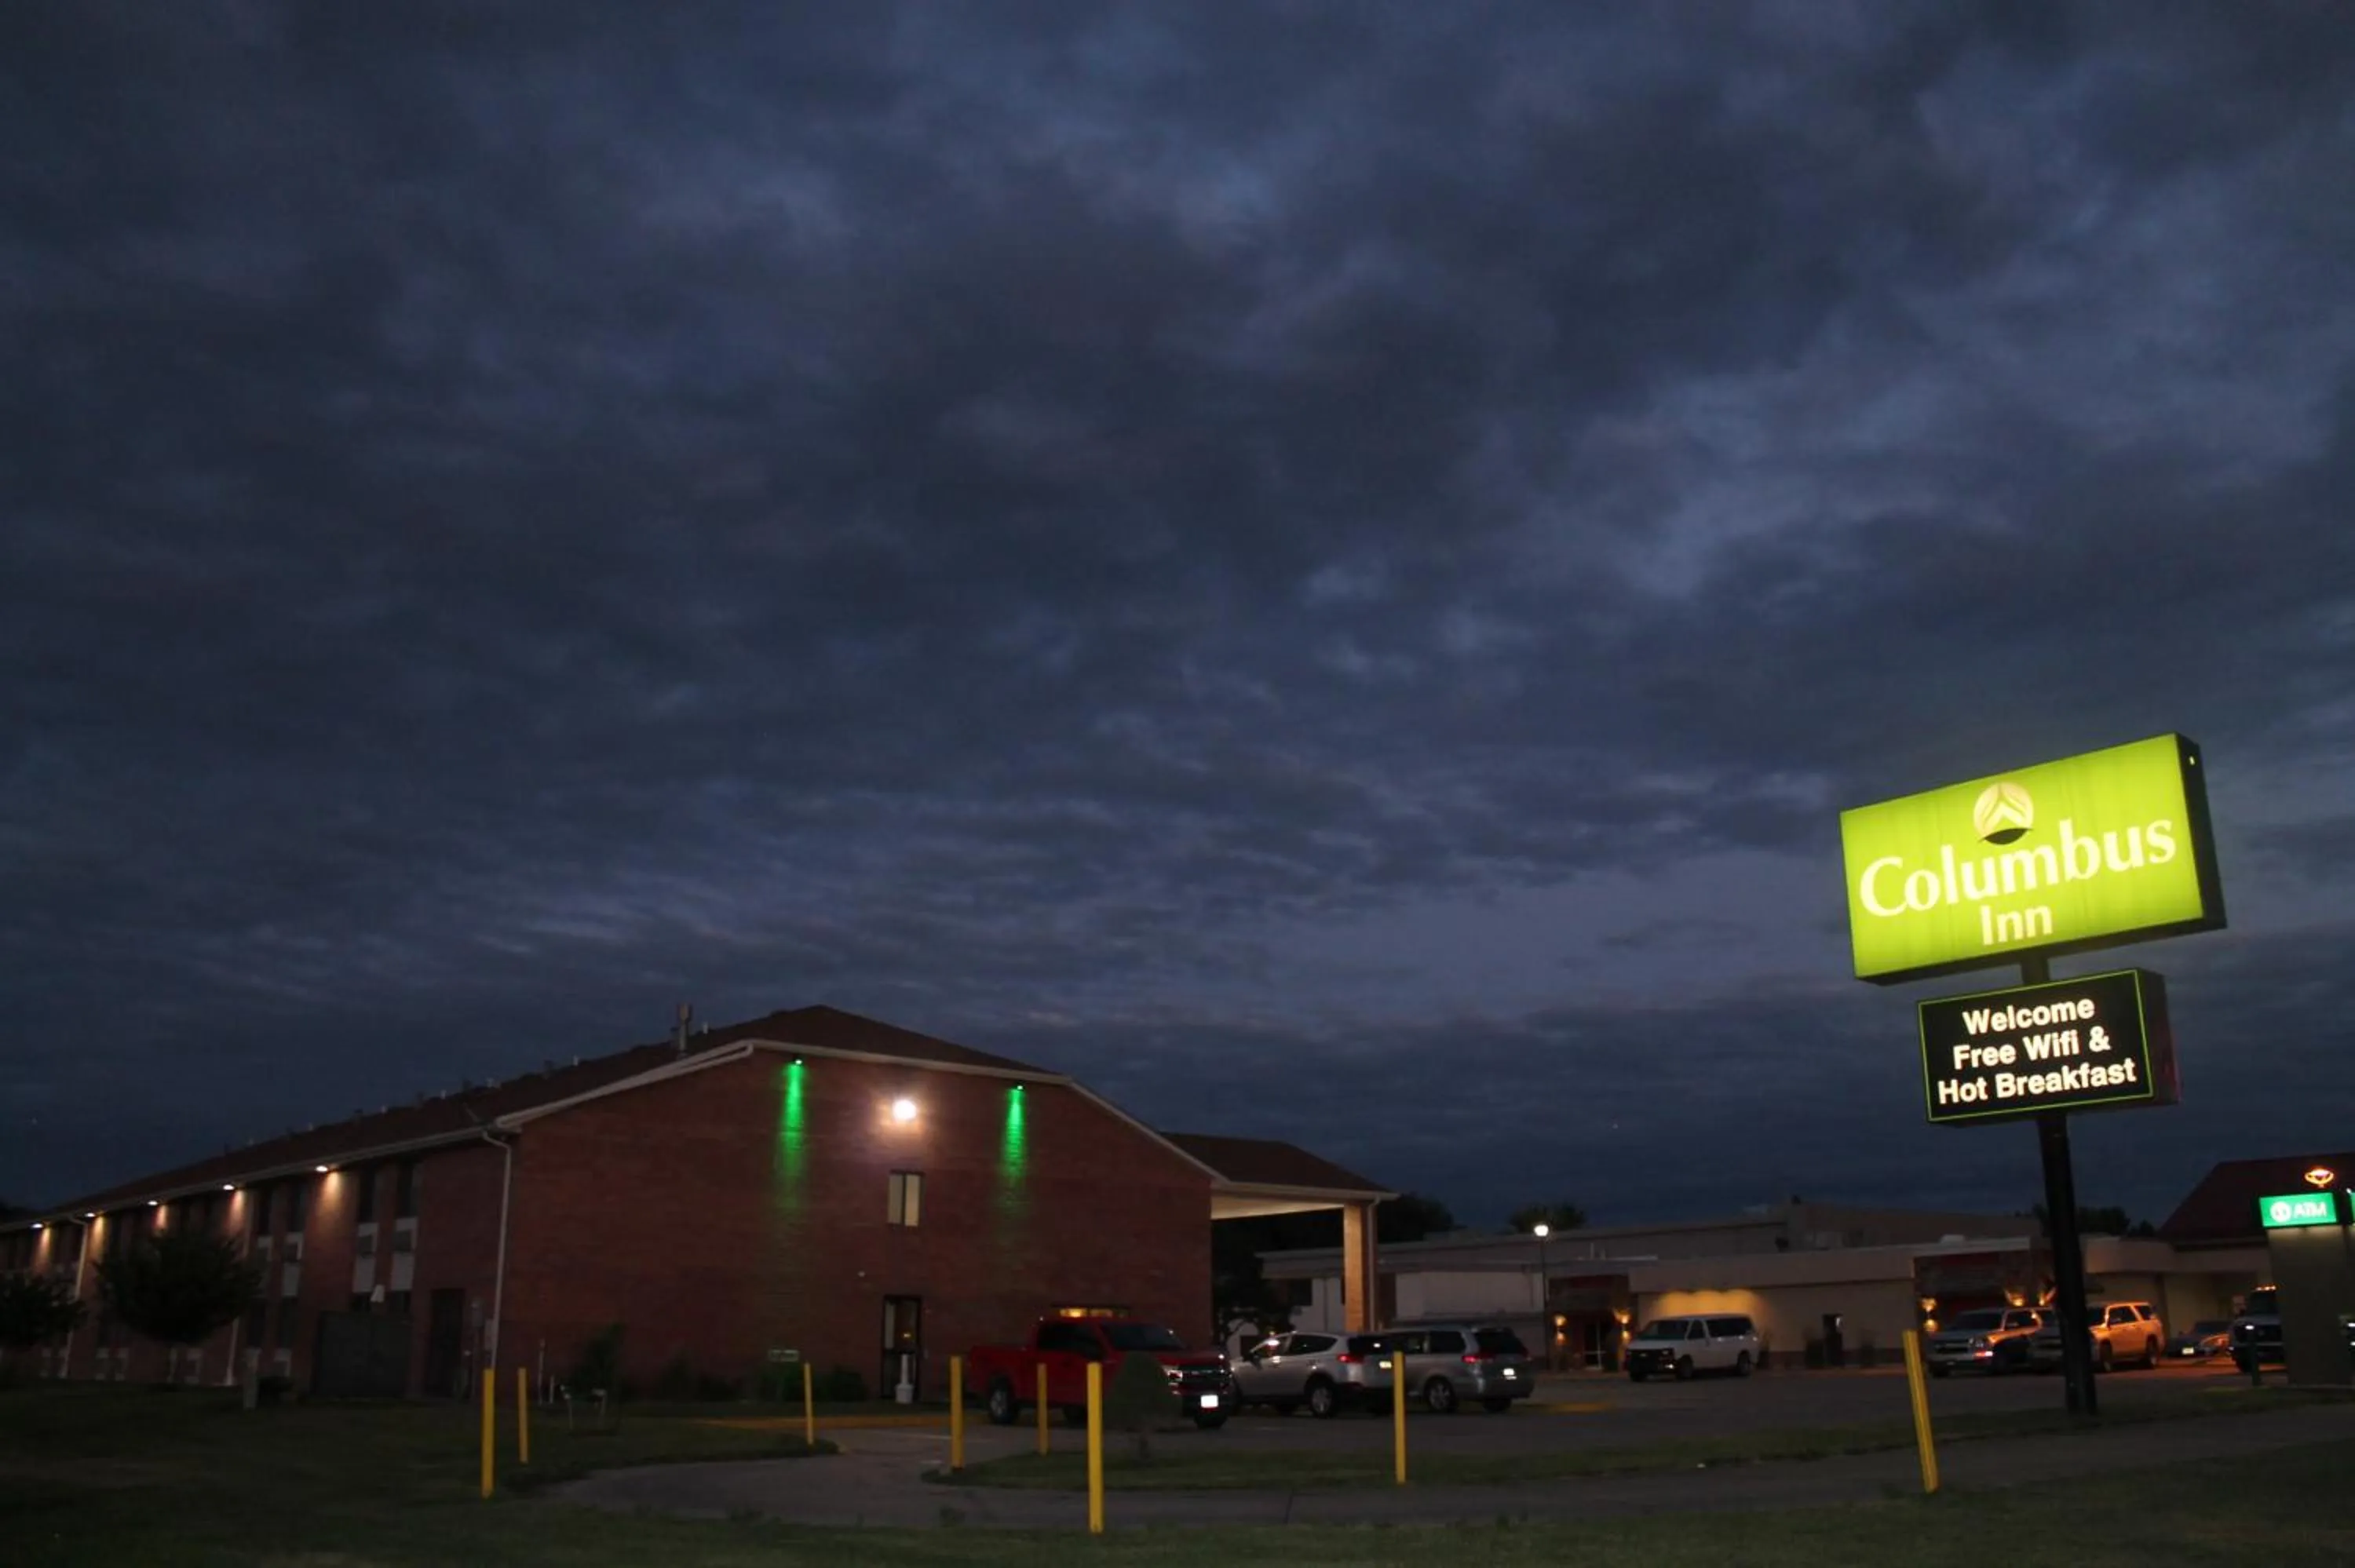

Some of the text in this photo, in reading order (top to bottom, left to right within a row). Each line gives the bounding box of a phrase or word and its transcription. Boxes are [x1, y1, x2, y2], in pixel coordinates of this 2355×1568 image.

[1859, 818, 2177, 917] Columbus
[1980, 904, 2053, 945] Inn
[1962, 998, 2095, 1035] Welcome
[1953, 1026, 2112, 1070] Free Wifi &
[1937, 1057, 2137, 1104] Hot Breakfast
[2294, 1202, 2328, 1218] ATM
